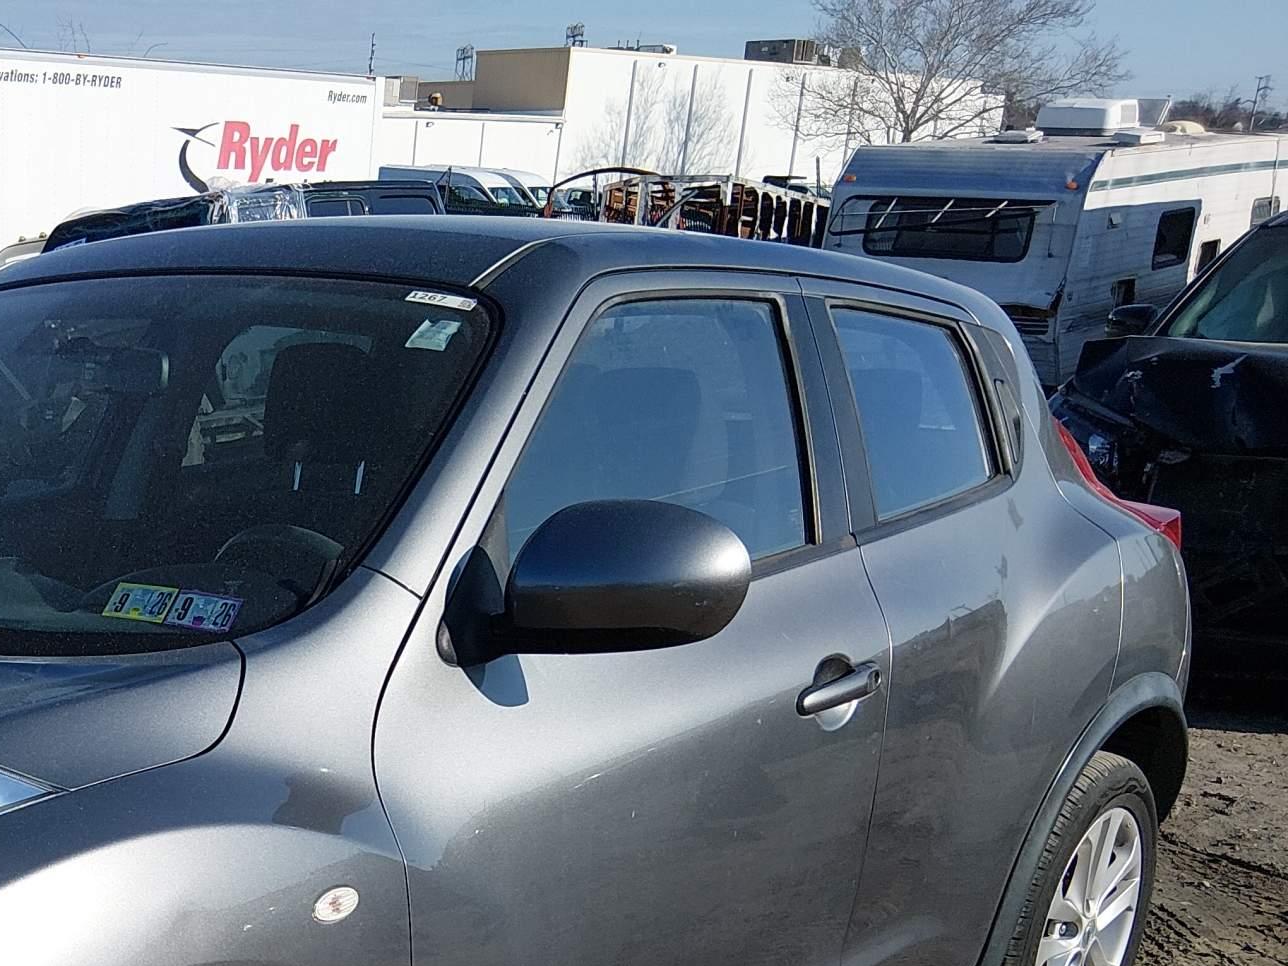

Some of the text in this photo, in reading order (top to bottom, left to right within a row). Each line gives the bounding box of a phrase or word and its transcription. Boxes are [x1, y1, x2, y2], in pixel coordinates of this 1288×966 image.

[42, 72, 122, 89] 1-800-BY-RYDER
[327, 90, 367, 104] Ryder.com
[216, 120, 338, 183] Ryder
[409, 292, 448, 302] 1267
